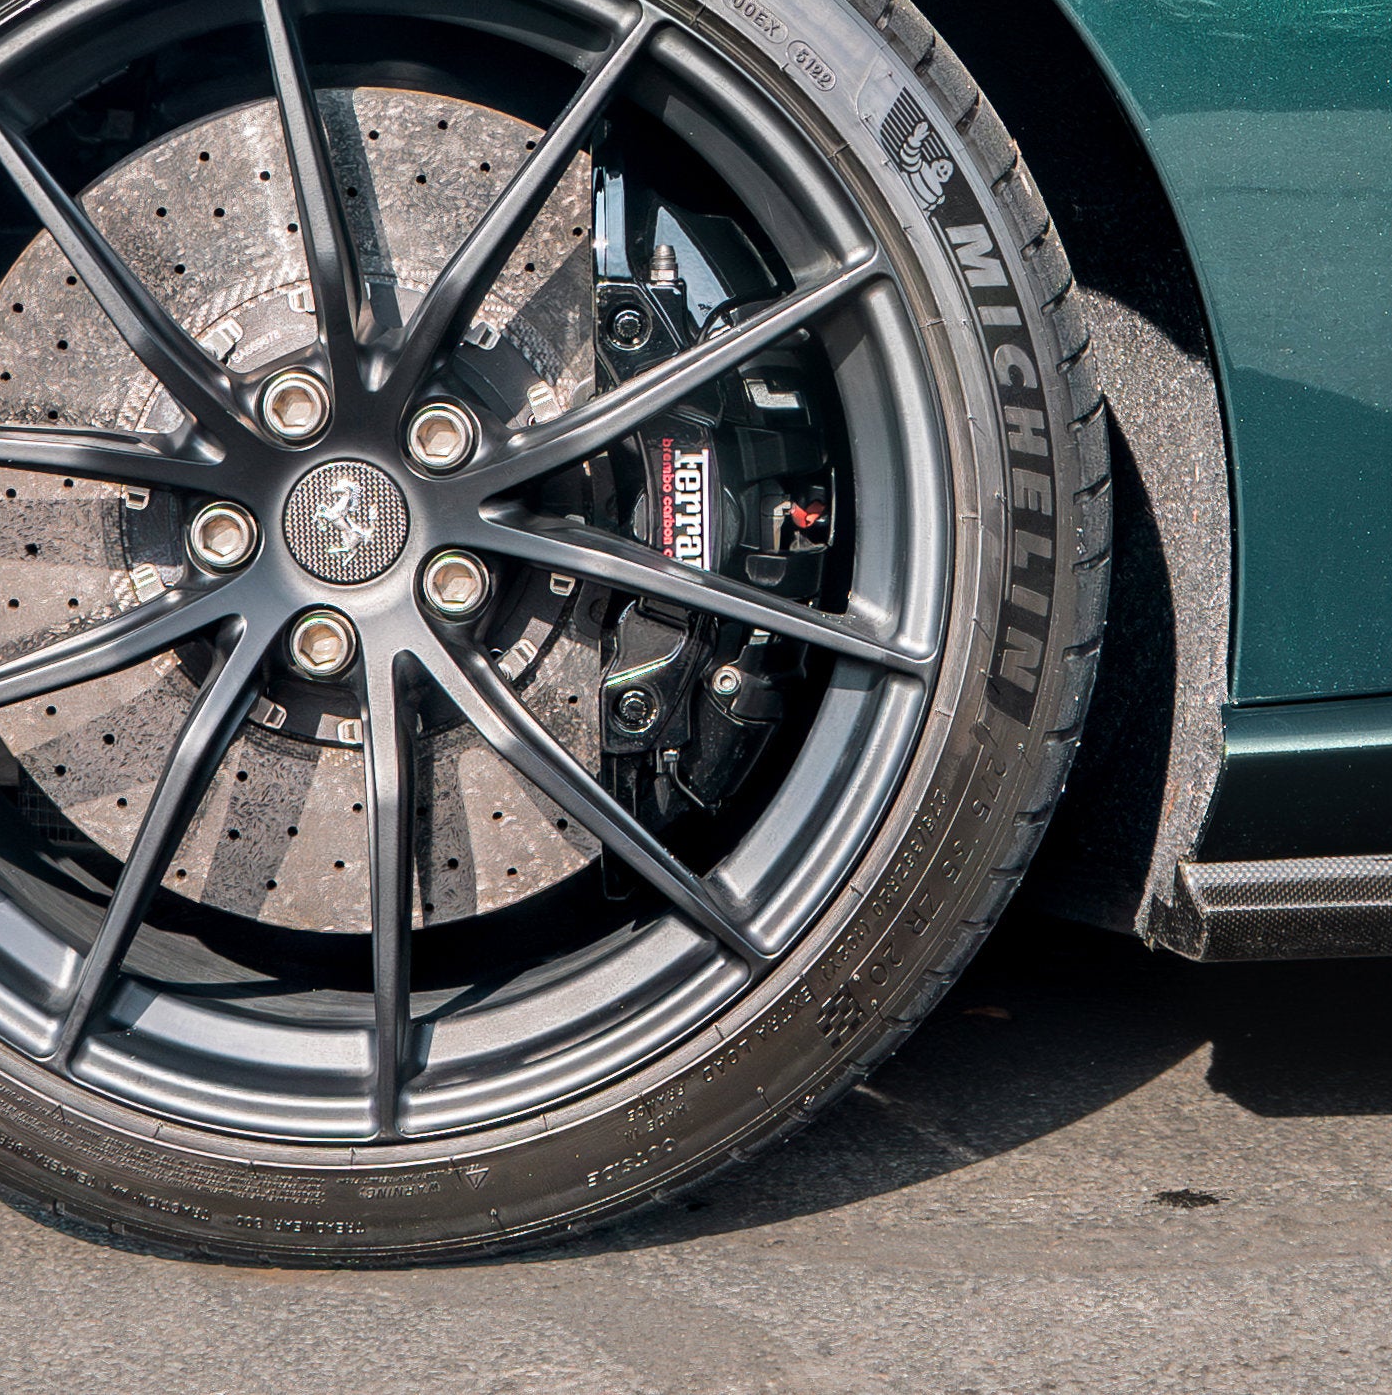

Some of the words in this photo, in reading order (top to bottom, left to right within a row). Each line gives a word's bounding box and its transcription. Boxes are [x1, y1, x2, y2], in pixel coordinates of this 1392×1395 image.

[795, 48, 834, 88] 5122
[663, 438, 674, 493] brembo
[943, 224, 1053, 693] MICHELIN
[663, 495, 675, 545] carbon
[971, 756, 1009, 823] 275
[941, 836, 974, 886] 35
[903, 891, 947, 937] ZR
[867, 941, 907, 988] 20
[753, 983, 813, 1041] EXTRA
[699, 1036, 753, 1085] LOAD
[585, 1133, 678, 1188] OUTSIDE
[273, 1216, 366, 1234] TREADWEAR
